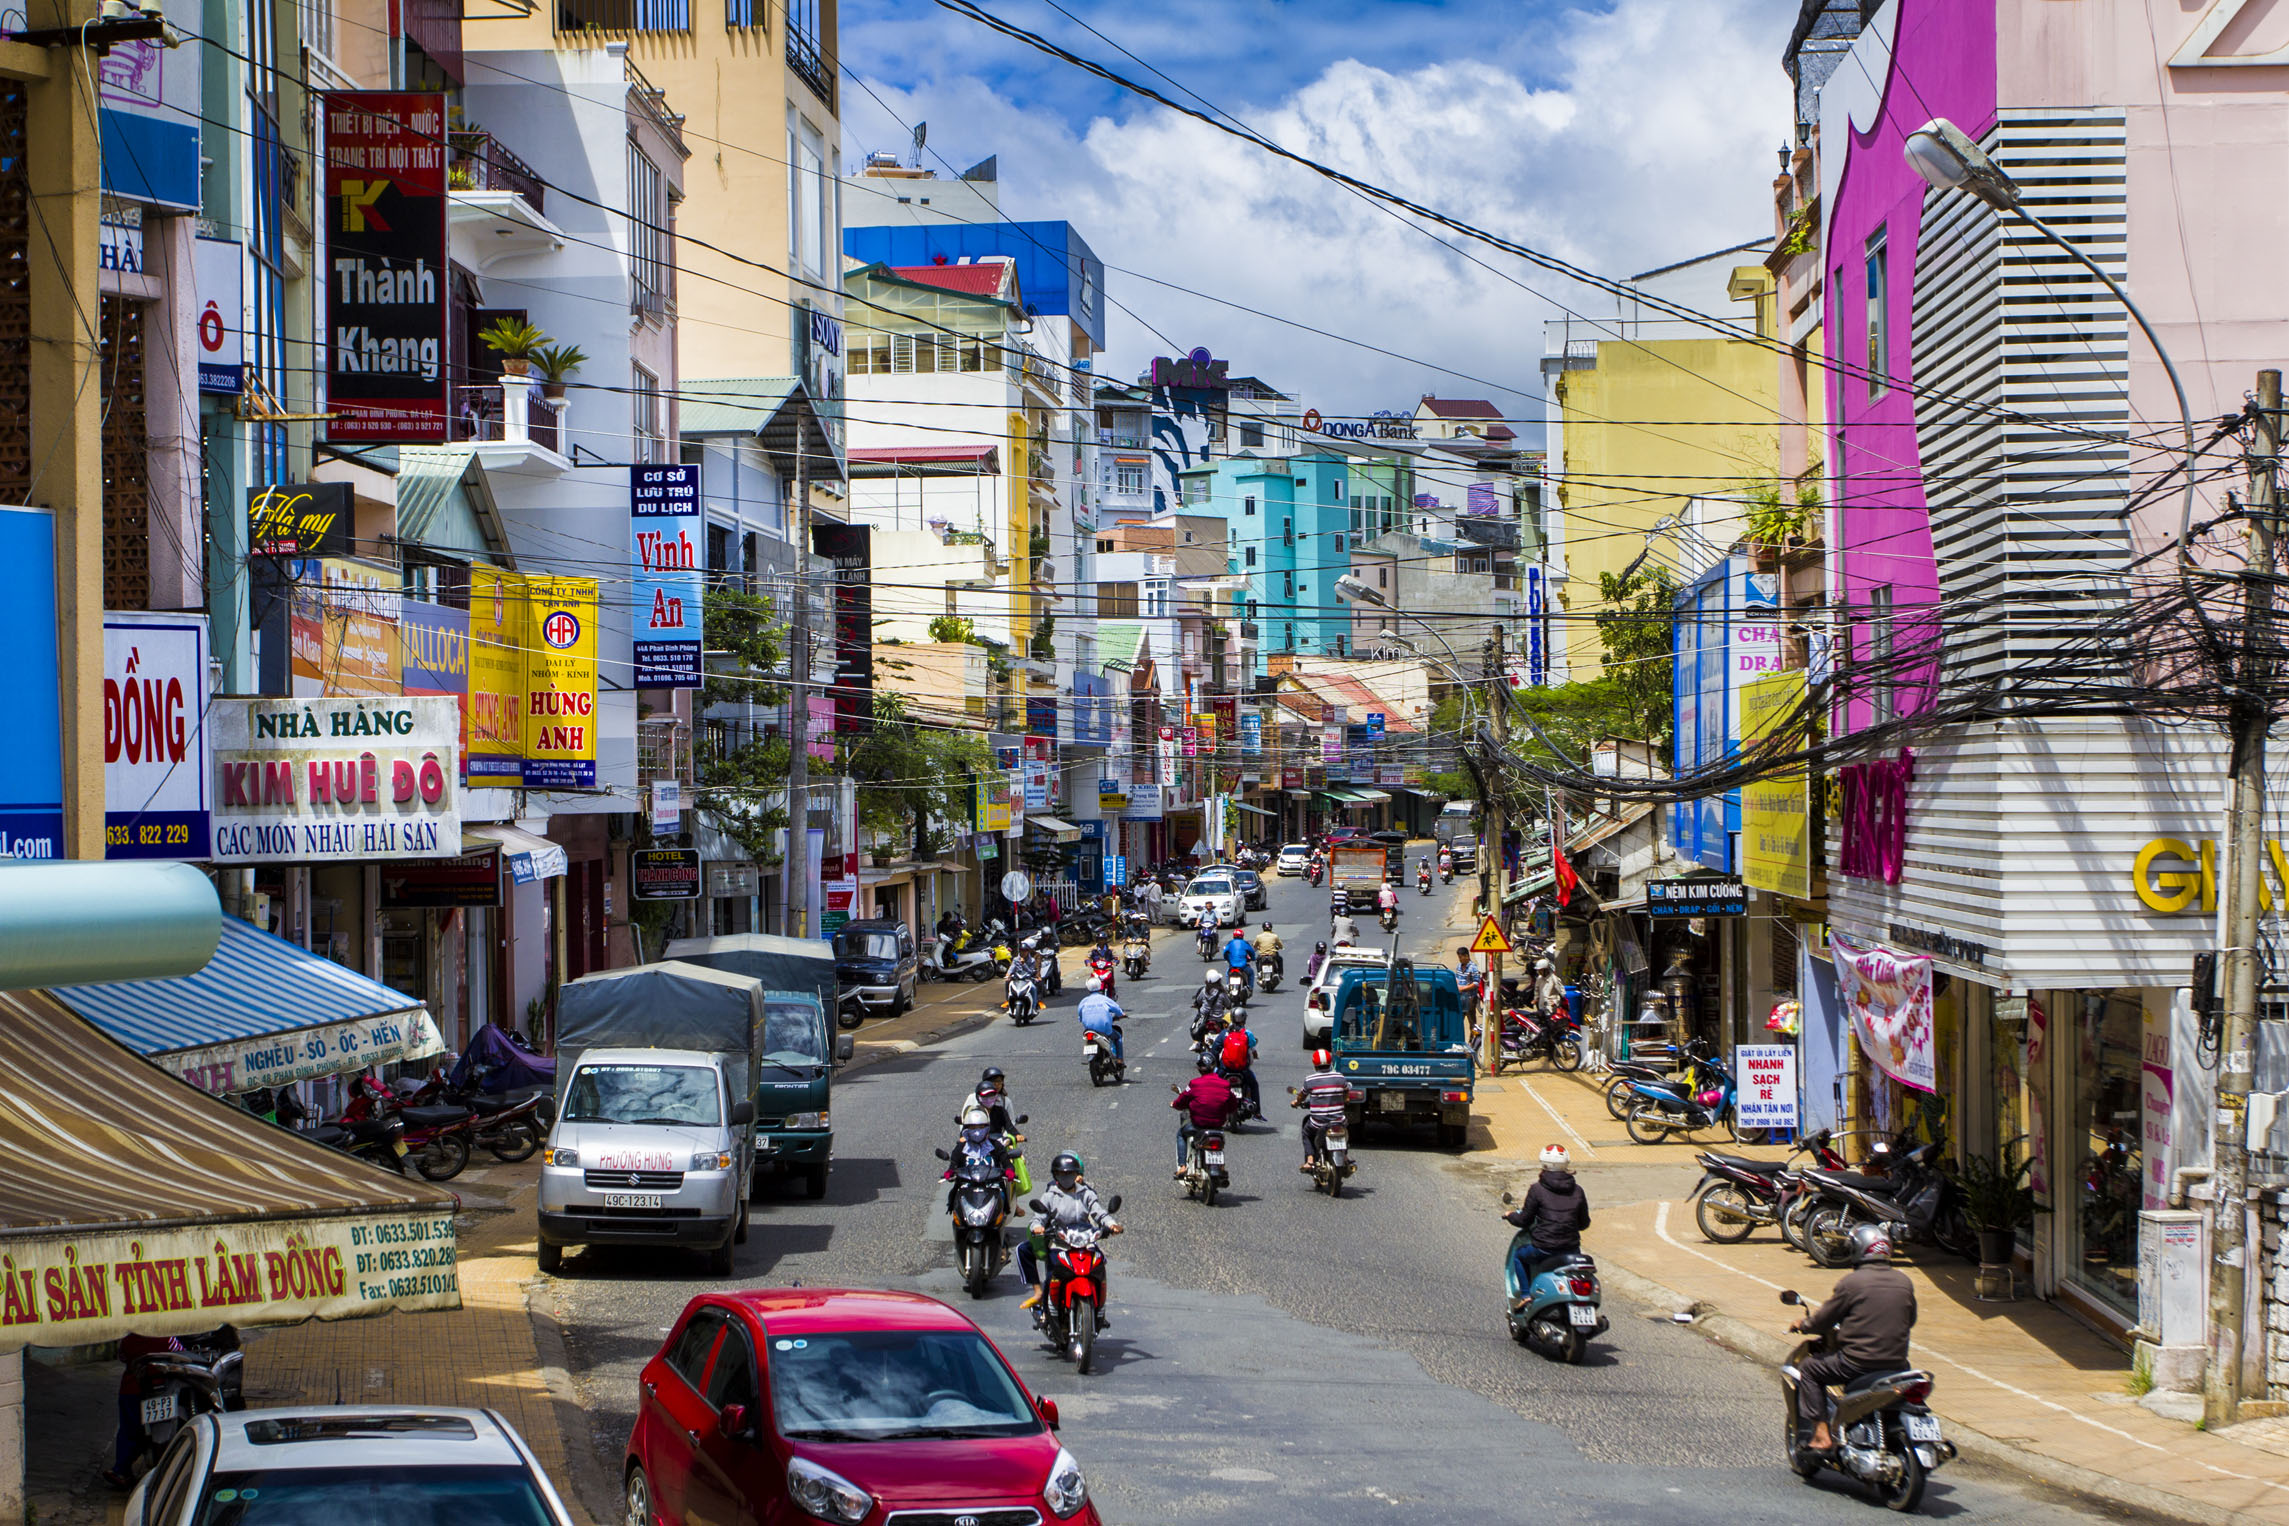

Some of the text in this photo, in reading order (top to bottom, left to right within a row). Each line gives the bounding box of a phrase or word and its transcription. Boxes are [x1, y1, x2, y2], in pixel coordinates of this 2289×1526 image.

[330, 106, 439, 139] THIẾT BỊ ĐIỆN NƯỚC
[330, 142, 440, 174] TRANG TRÍ NỘI THẤT
[336, 257, 436, 305] Thành
[338, 326, 439, 382] Khang
[1379, 422, 1418, 440] Bank
[643, 468, 686, 482] CƠ SỞ
[666, 484, 694, 497] TRÚ
[638, 502, 693, 514] DU LỊCH
[636, 529, 695, 573] Vinh
[530, 585, 594, 597] CÔNG TY TNHH
[650, 588, 684, 628] An
[531, 667, 590, 678] NHÔM KÍNH
[545, 658, 576, 669] ĐẠI LÝ
[104, 647, 187, 765] ĐỒNG
[529, 682, 592, 716] HÙNG
[257, 704, 414, 739] NHÀ HÀNG
[536, 726, 584, 750] ANH
[223, 751, 445, 806] KIM HUÊ ĐÔ
[140, 825, 161, 844] 822
[166, 824, 189, 844] 229
[217, 817, 439, 856] CÁC MÓN NHẬU HẢI SẢN
[0, 831, 52, 859] l.com
[648, 851, 685, 861] HOTEL
[637, 866, 670, 882] THÀNH
[1665, 881, 1687, 902] NỆM
[1688, 884, 1708, 899] KIM
[1679, 905, 1700, 914] DRAP
[245, 1021, 402, 1073] NGHÊU SÒ ỐC HẾN
[2145, 1032, 2169, 1066] ZAGO
[273, 1069, 294, 1081] PHAN
[295, 1063, 314, 1078] ĐÌNH
[316, 1058, 341, 1073] PHÙNG
[1381, 1065, 1399, 1075] 79C
[1402, 1065, 1430, 1075] 03477
[1748, 1059, 1784, 1070] NHANH
[1753, 1074, 1780, 1087] SẠCH
[1760, 1085, 1773, 1100] RẺ
[757, 1137, 767, 1148] 37
[605, 1195, 660, 1208] 49C-123.14
[350, 1220, 455, 1246] ĐT: 0633.501.539
[356, 1252, 377, 1273] ĐT:
[0, 1234, 346, 1325] ÀI SẢN TỈNH LÂM ĐỒNG
[359, 1281, 387, 1300] Fax:
[145, 1397, 173, 1410] 49-P3
[146, 1407, 173, 1422] 7737
[958, 1518, 975, 1526] KIA
